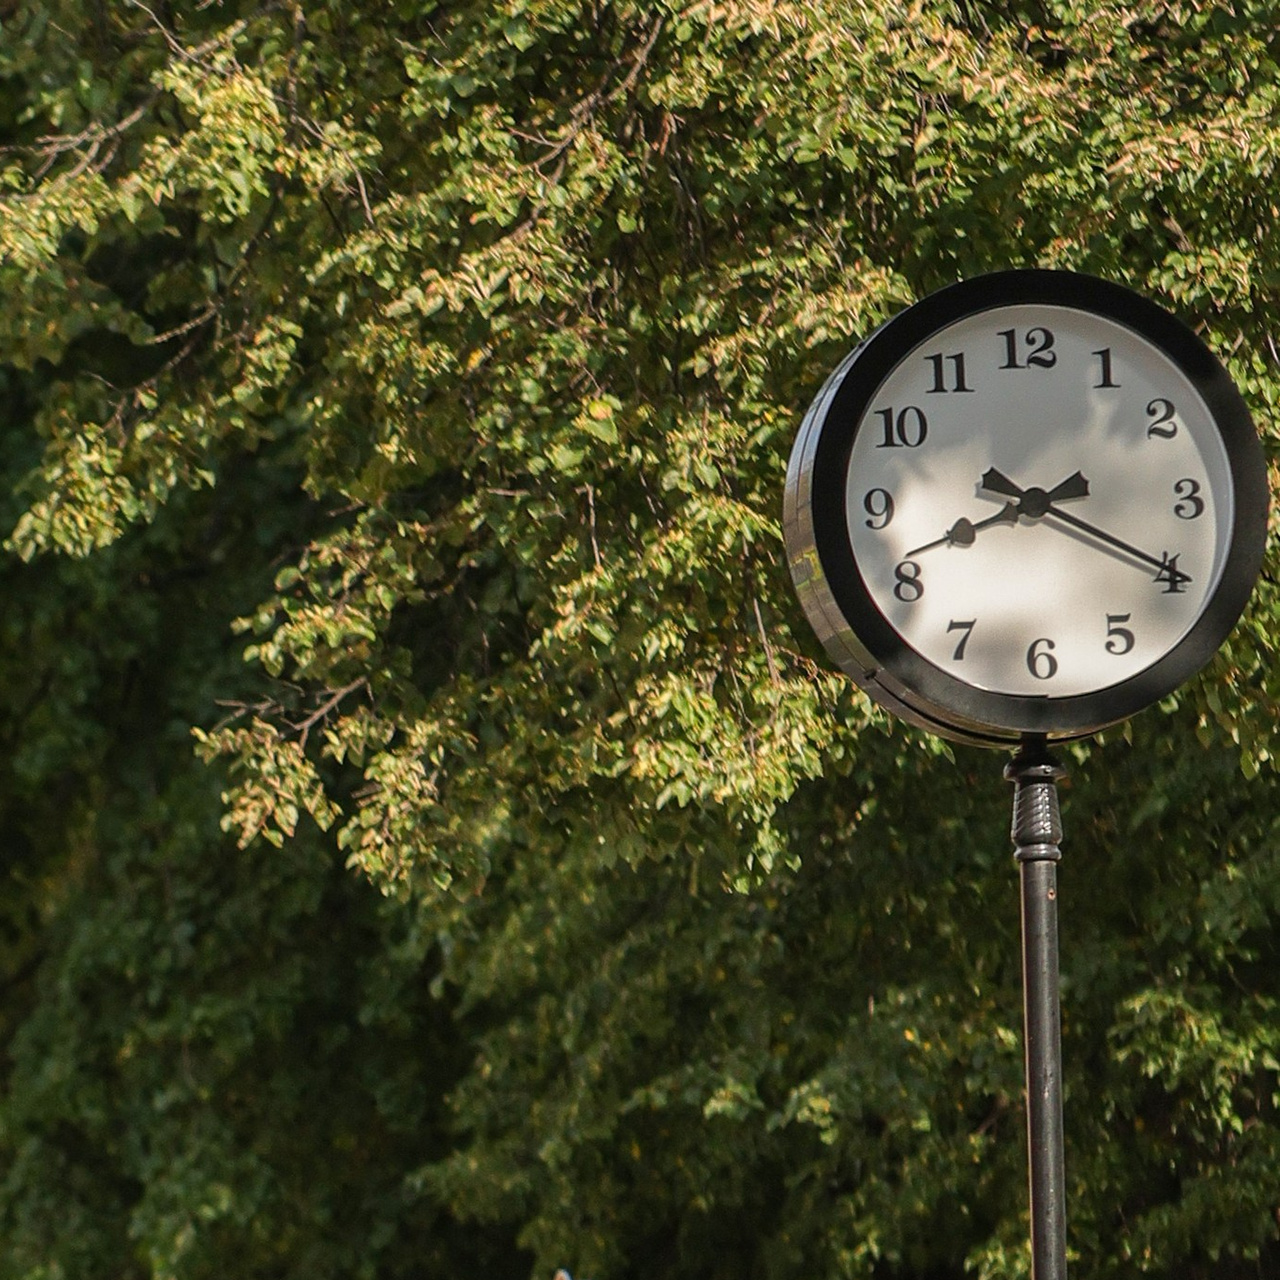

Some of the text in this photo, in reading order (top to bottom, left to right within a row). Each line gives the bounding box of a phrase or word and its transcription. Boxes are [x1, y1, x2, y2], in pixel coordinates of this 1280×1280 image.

[997, 327, 1058, 370] 12
[1091, 348, 1121, 389] 1
[924, 352, 975, 394] 11
[874, 406, 928, 448] 10
[1146, 398, 1178, 440] 2
[863, 488, 895, 530] 9
[1173, 478, 1205, 520] 3
[893, 561, 925, 603] 8
[1153, 551, 1188, 594] 4
[946, 618, 978, 661] 7
[1104, 612, 1136, 656] 5
[1026, 638, 1059, 681] 6
